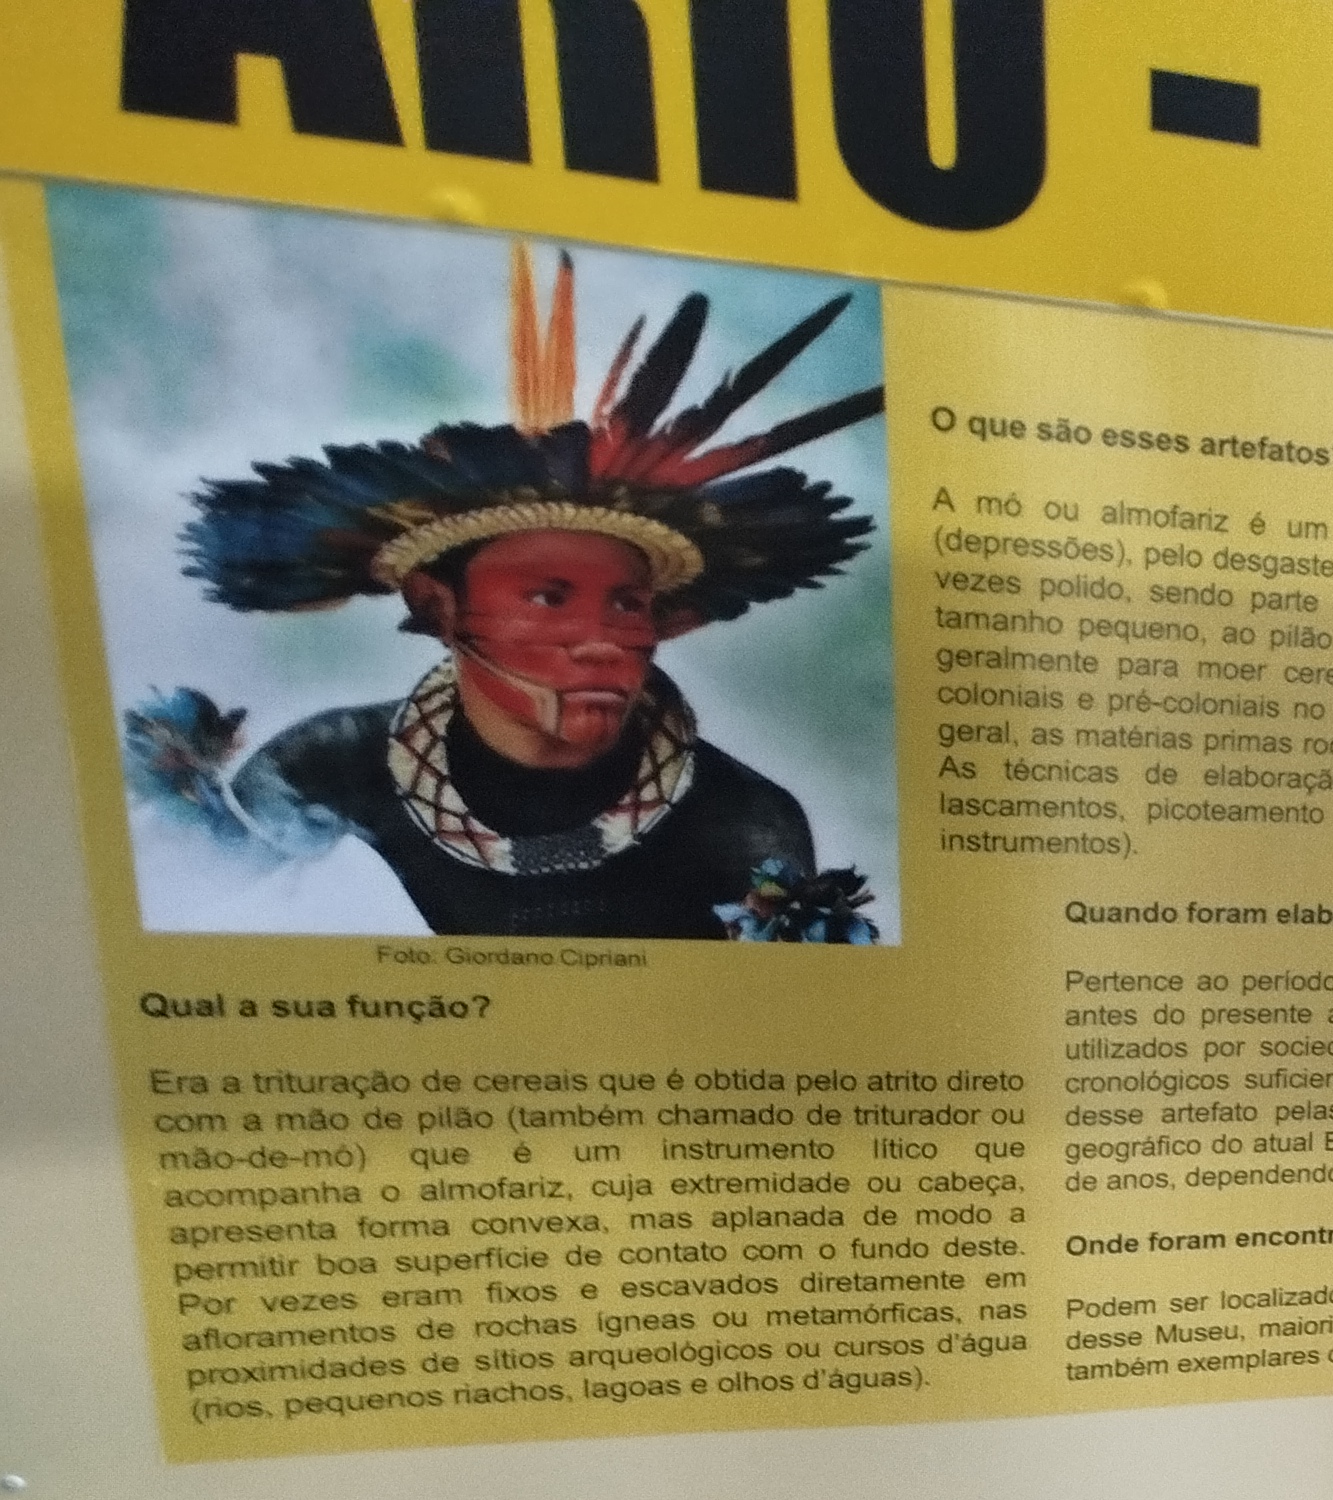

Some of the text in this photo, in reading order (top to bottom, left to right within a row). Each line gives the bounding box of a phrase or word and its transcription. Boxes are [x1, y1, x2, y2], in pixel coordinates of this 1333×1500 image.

[928, 403, 958, 431] O
[965, 414, 1028, 444] que
[1034, 414, 1093, 445] são
[1099, 427, 1192, 454] esses
[932, 525, 1132, 568] (depressões),
[1142, 539, 1204, 573] pelo
[934, 641, 1099, 678] geralmente
[1115, 656, 1179, 682] para
[1195, 660, 1268, 682] moer
[934, 679, 1064, 708] coloniais
[1075, 691, 1097, 709] e
[1105, 686, 1281, 723] pré-coloniais
[1290, 701, 1326, 720] no
[938, 790, 1125, 822] lascamentos,
[1144, 795, 1326, 830] picoteamento
[939, 826, 1138, 859] instrumentos).
[1063, 897, 1179, 922] Quando
[1185, 897, 1269, 923] foram
[376, 940, 647, 972] Foto: Giordano Cipriani
[137, 988, 492, 1024] Qual a sua função?
[1063, 1067, 1231, 1096] cronológicos
[162, 1169, 1025, 1213] acompanha o almofariz, cuja extremidade ou cabeça,
[1064, 1226, 1140, 1255] Onde
[1146, 1222, 1227, 1250] foram
[171, 1233, 1025, 1286] permitir boa superfície de contato com o fundo deste.
[1064, 1349, 1170, 1380] também
[1175, 1340, 1321, 1378] exemplares
[188, 1363, 930, 1426] (rios, pequenos riachos, lagoas e olhos d'águas).
